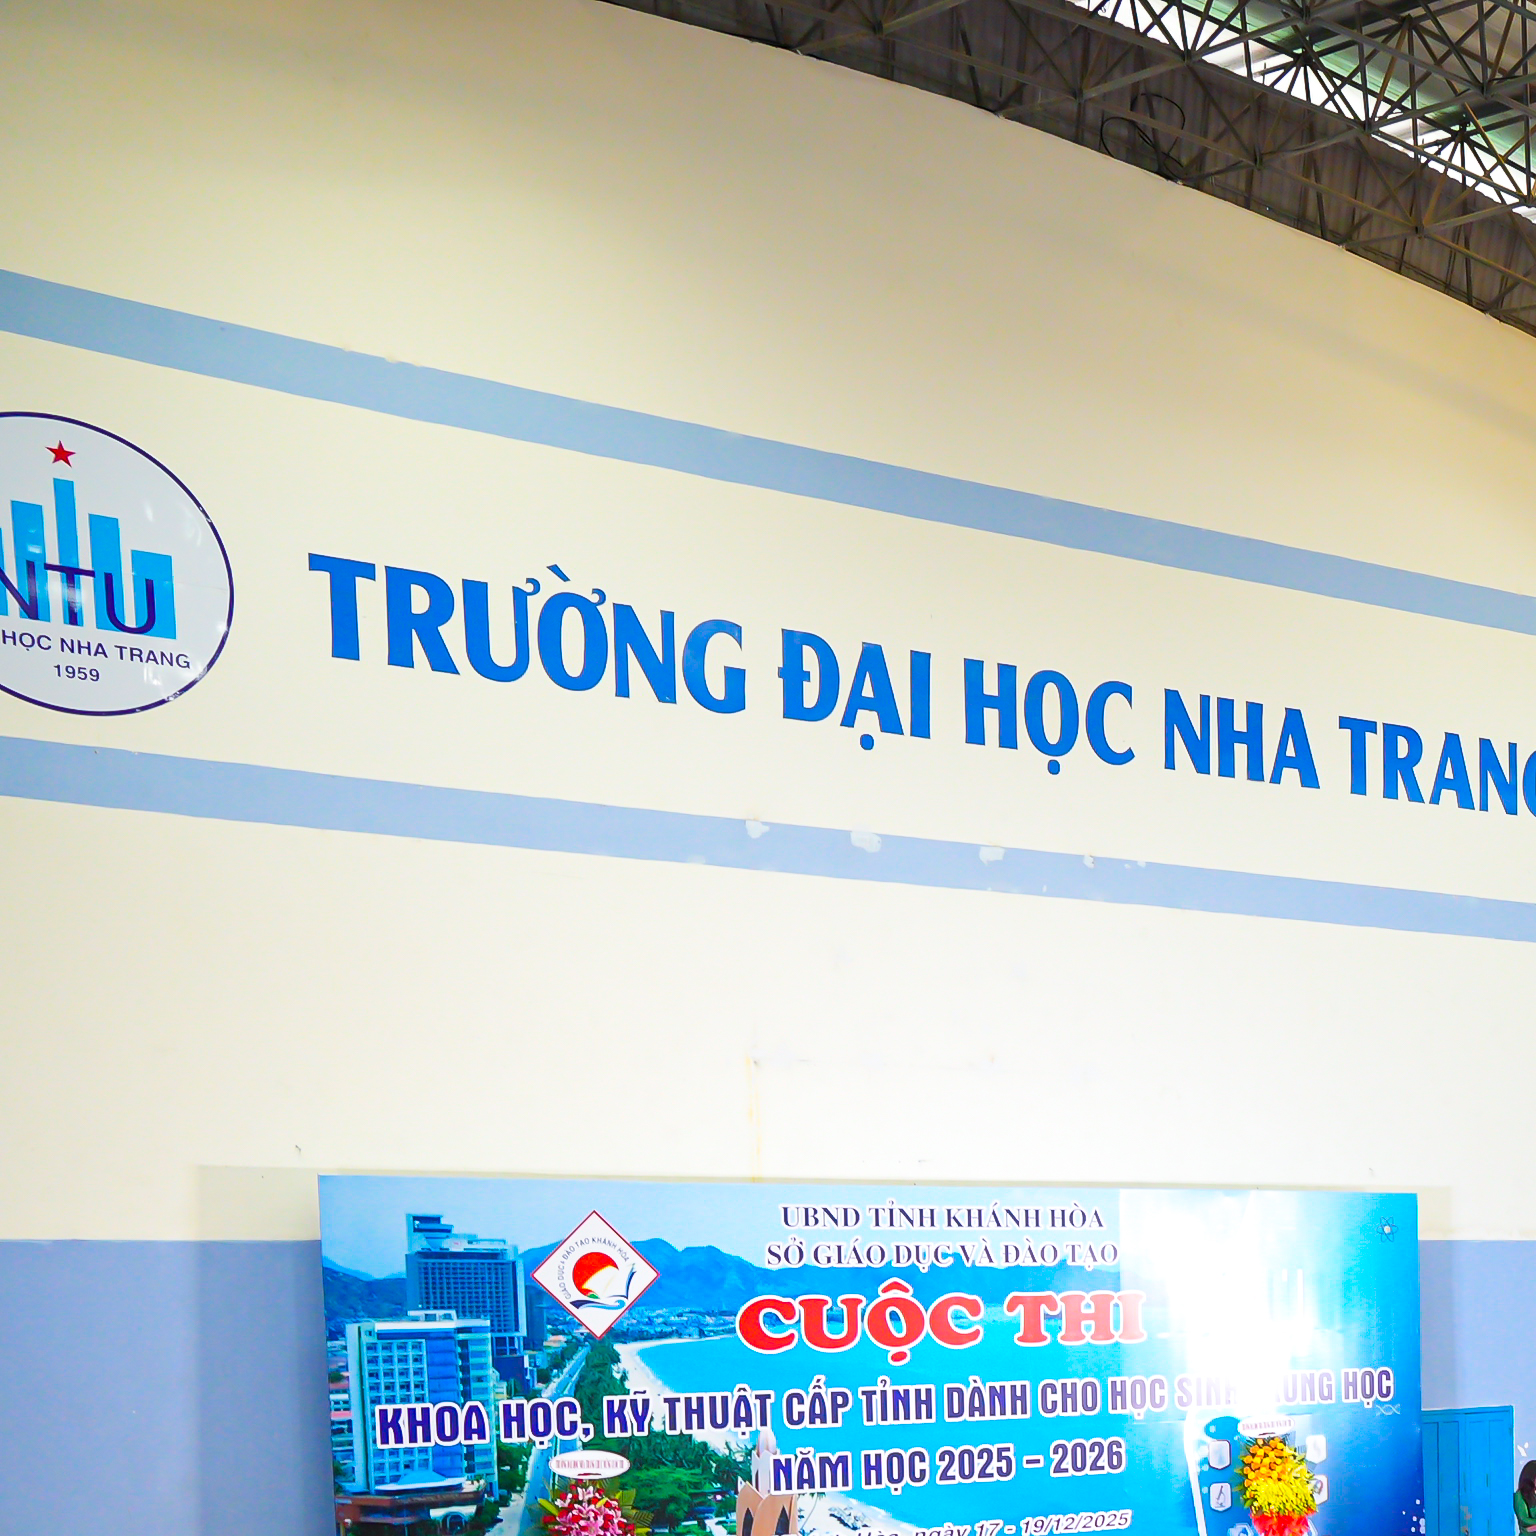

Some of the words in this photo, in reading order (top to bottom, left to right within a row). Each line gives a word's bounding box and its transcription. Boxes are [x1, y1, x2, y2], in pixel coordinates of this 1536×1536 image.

[1, 630, 52, 656] HỌC
[59, 638, 108, 659] NHA
[114, 646, 191, 671] TRANG
[308, 552, 747, 714] TRƯỜNG
[778, 628, 931, 751] ĐẠI
[963, 658, 1135, 775] HỌC
[1164, 688, 1320, 789] NHA
[52, 664, 101, 683] 1959
[780, 1205, 860, 1229] UBND
[868, 1198, 938, 1229] TỈNH
[943, 1201, 1037, 1229] KHÁNH
[1049, 1203, 1105, 1230] HÒA
[766, 1241, 806, 1267] SỞ
[813, 1241, 887, 1266] GIÁO
[894, 1244, 951, 1273] DỤC
[958, 1241, 995, 1267] VÀ
[1002, 1241, 1060, 1266] ĐÀO
[1064, 1243, 1118, 1272] TẠO
[738, 1278, 983, 1365] CUỘC
[1005, 1290, 1147, 1344] THI
[378, 1406, 487, 1446] KHOA
[502, 1399, 594, 1448] HỌC,
[605, 1390, 652, 1437] KỸ
[665, 1388, 773, 1434] THUẬT
[784, 1375, 849, 1429] CẤP
[861, 1377, 933, 1426] TỈNH
[946, 1378, 1028, 1422] DÀNH
[1040, 1380, 1100, 1417] CHO
[1110, 1378, 1167, 1418] HỌC
[1344, 1370, 1394, 1406] HỌC
[771, 1450, 850, 1492] NĂM
[863, 1445, 927, 1495] HỌC
[936, 1446, 1015, 1483] 2025
[1050, 1440, 1125, 1477] 2026
[1021, 1510, 1132, 1536] 19/12/2025
